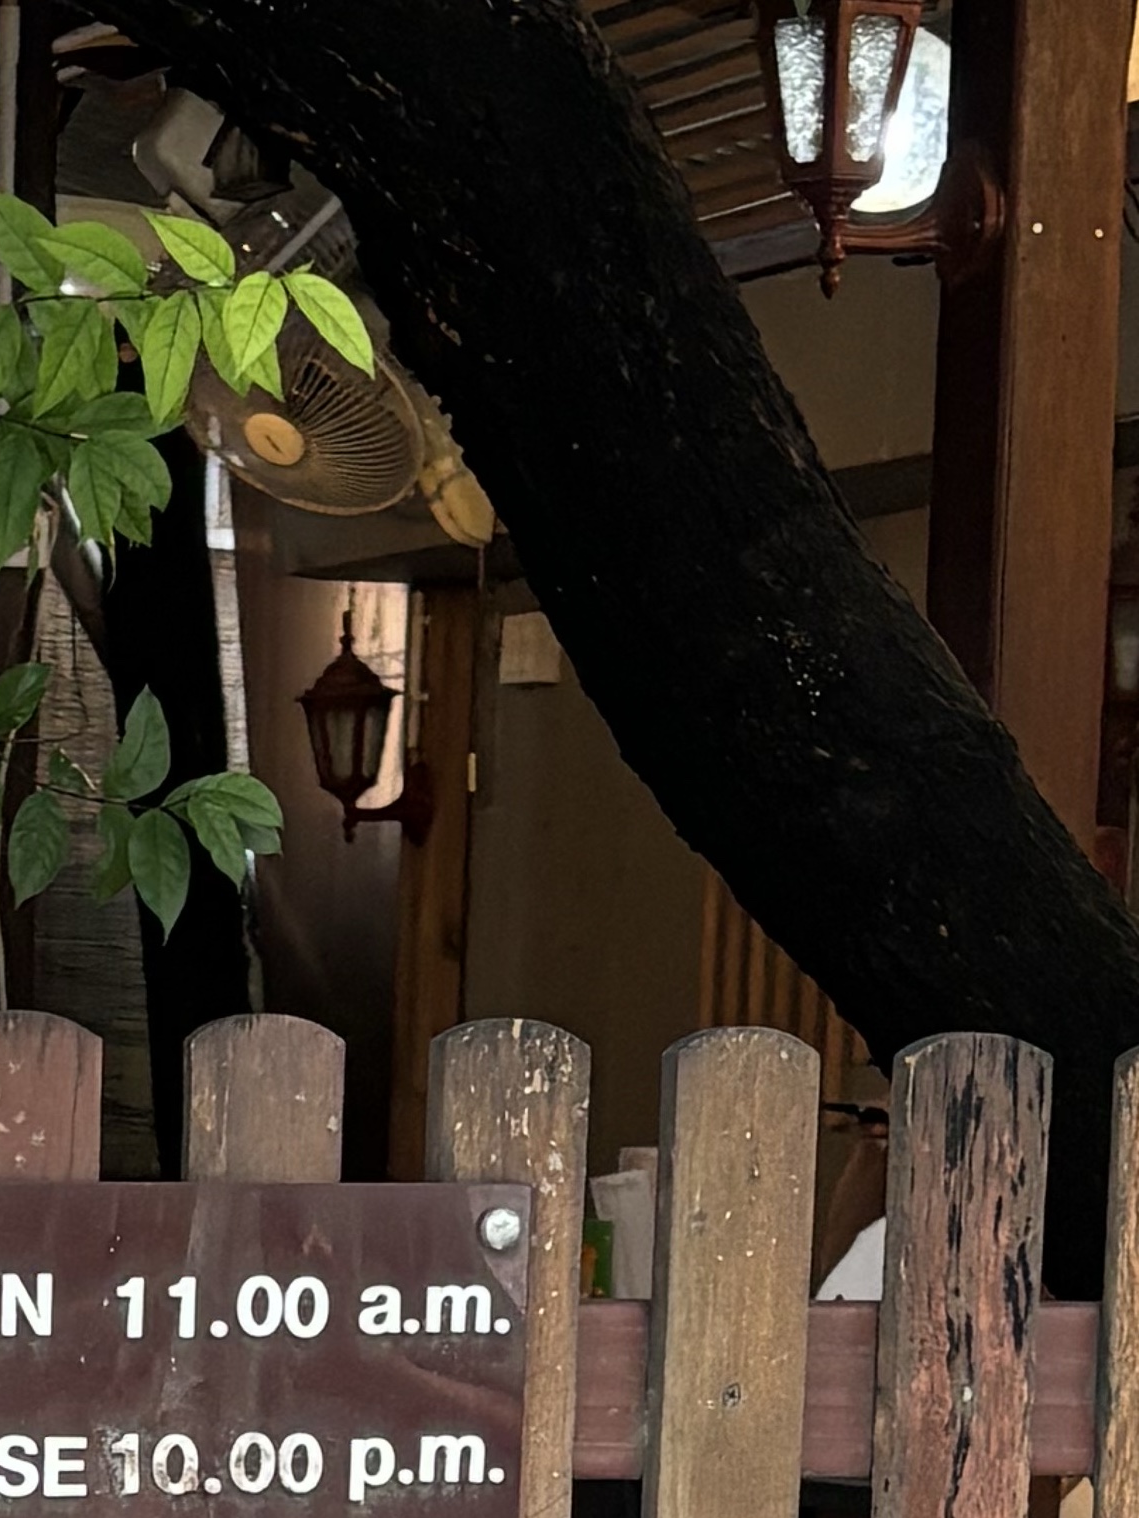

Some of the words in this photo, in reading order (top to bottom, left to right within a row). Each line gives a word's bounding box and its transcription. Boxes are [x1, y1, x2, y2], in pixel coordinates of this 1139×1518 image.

[116, 1275, 329, 1338] 11.00
[358, 1284, 511, 1335] a.m.
[109, 1431, 323, 1496] 10.00
[349, 1434, 505, 1502] p.m.
